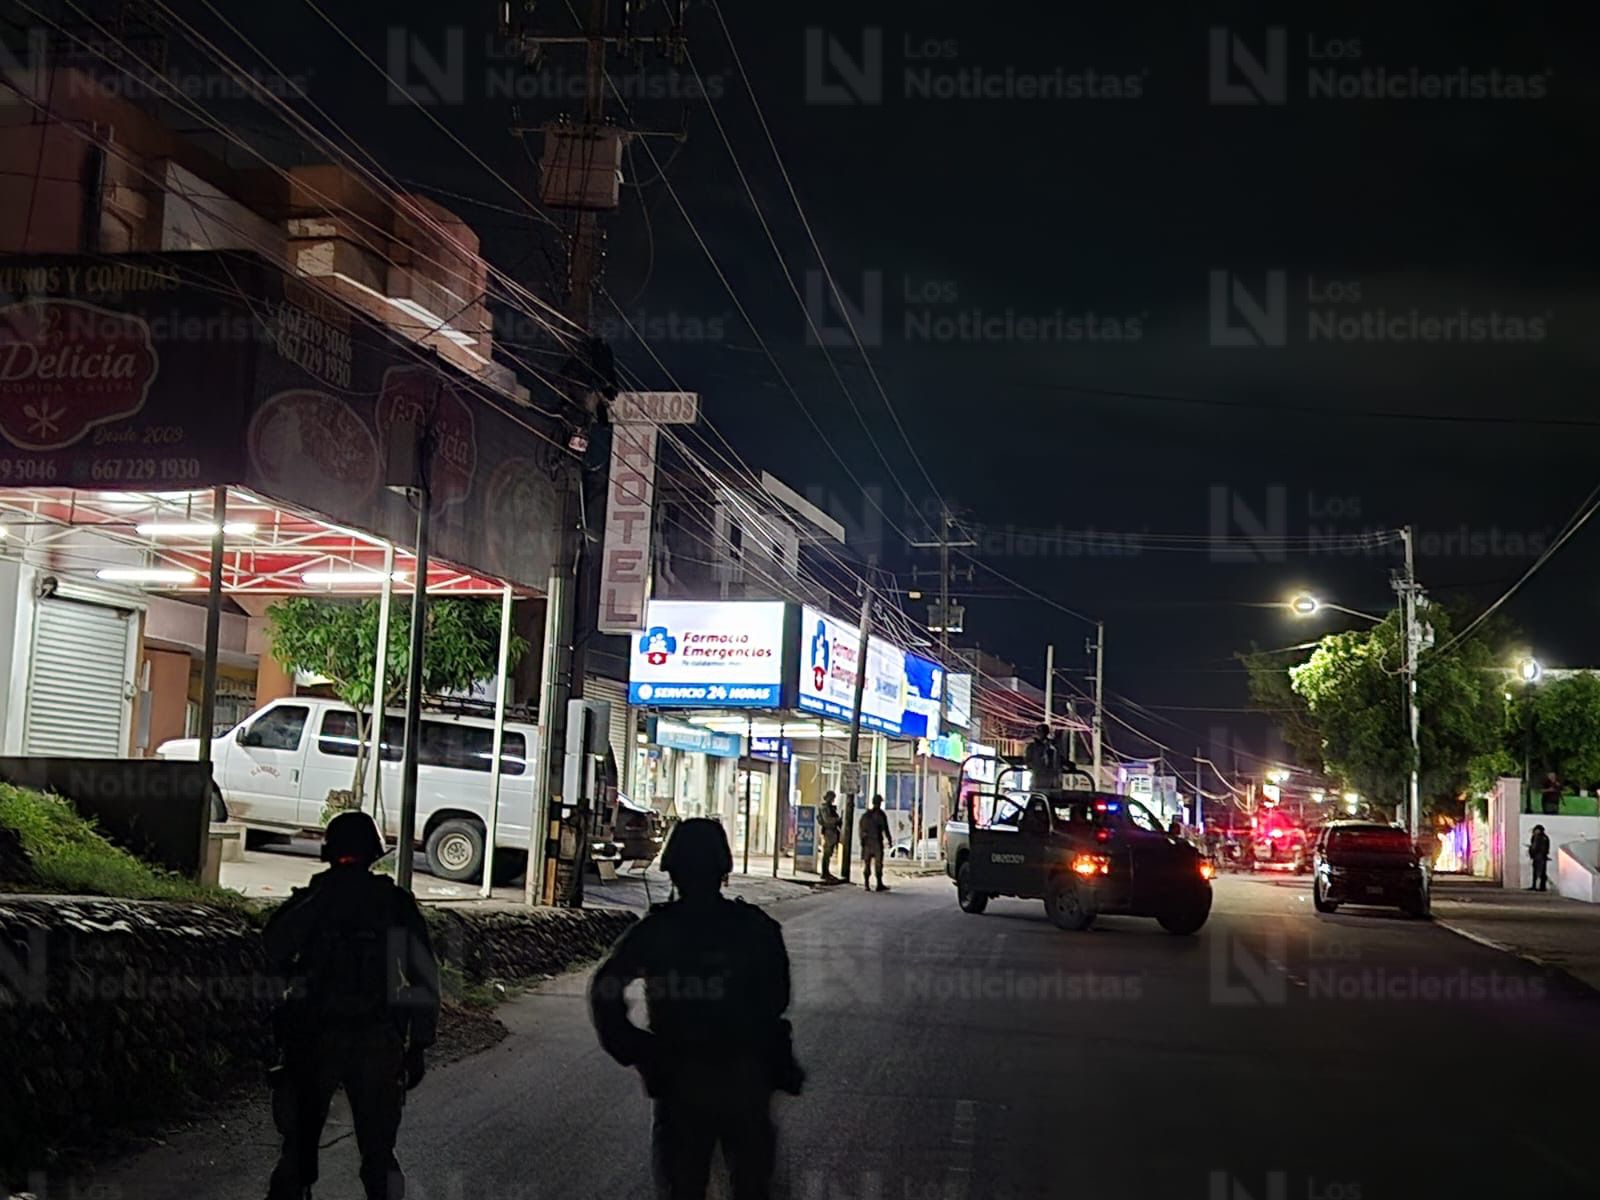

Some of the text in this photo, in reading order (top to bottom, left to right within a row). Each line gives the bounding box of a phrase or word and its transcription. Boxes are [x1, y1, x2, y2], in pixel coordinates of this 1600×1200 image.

[66, 265, 81, 292] Y
[85, 264, 181, 292] COMIDAS
[0, 342, 137, 381] Delicia
[143, 426, 184, 444] 2009
[16, 459, 57, 480] 5046
[91, 459, 122, 481] 667
[126, 458, 157, 480] 229
[160, 457, 200, 480] 1930
[605, 433, 652, 623] HOTEL
[683, 631, 749, 644] Farmacia
[682, 645, 772, 660] Emergencias
[655, 685, 771, 700] SERVICIO 24 HORAS
